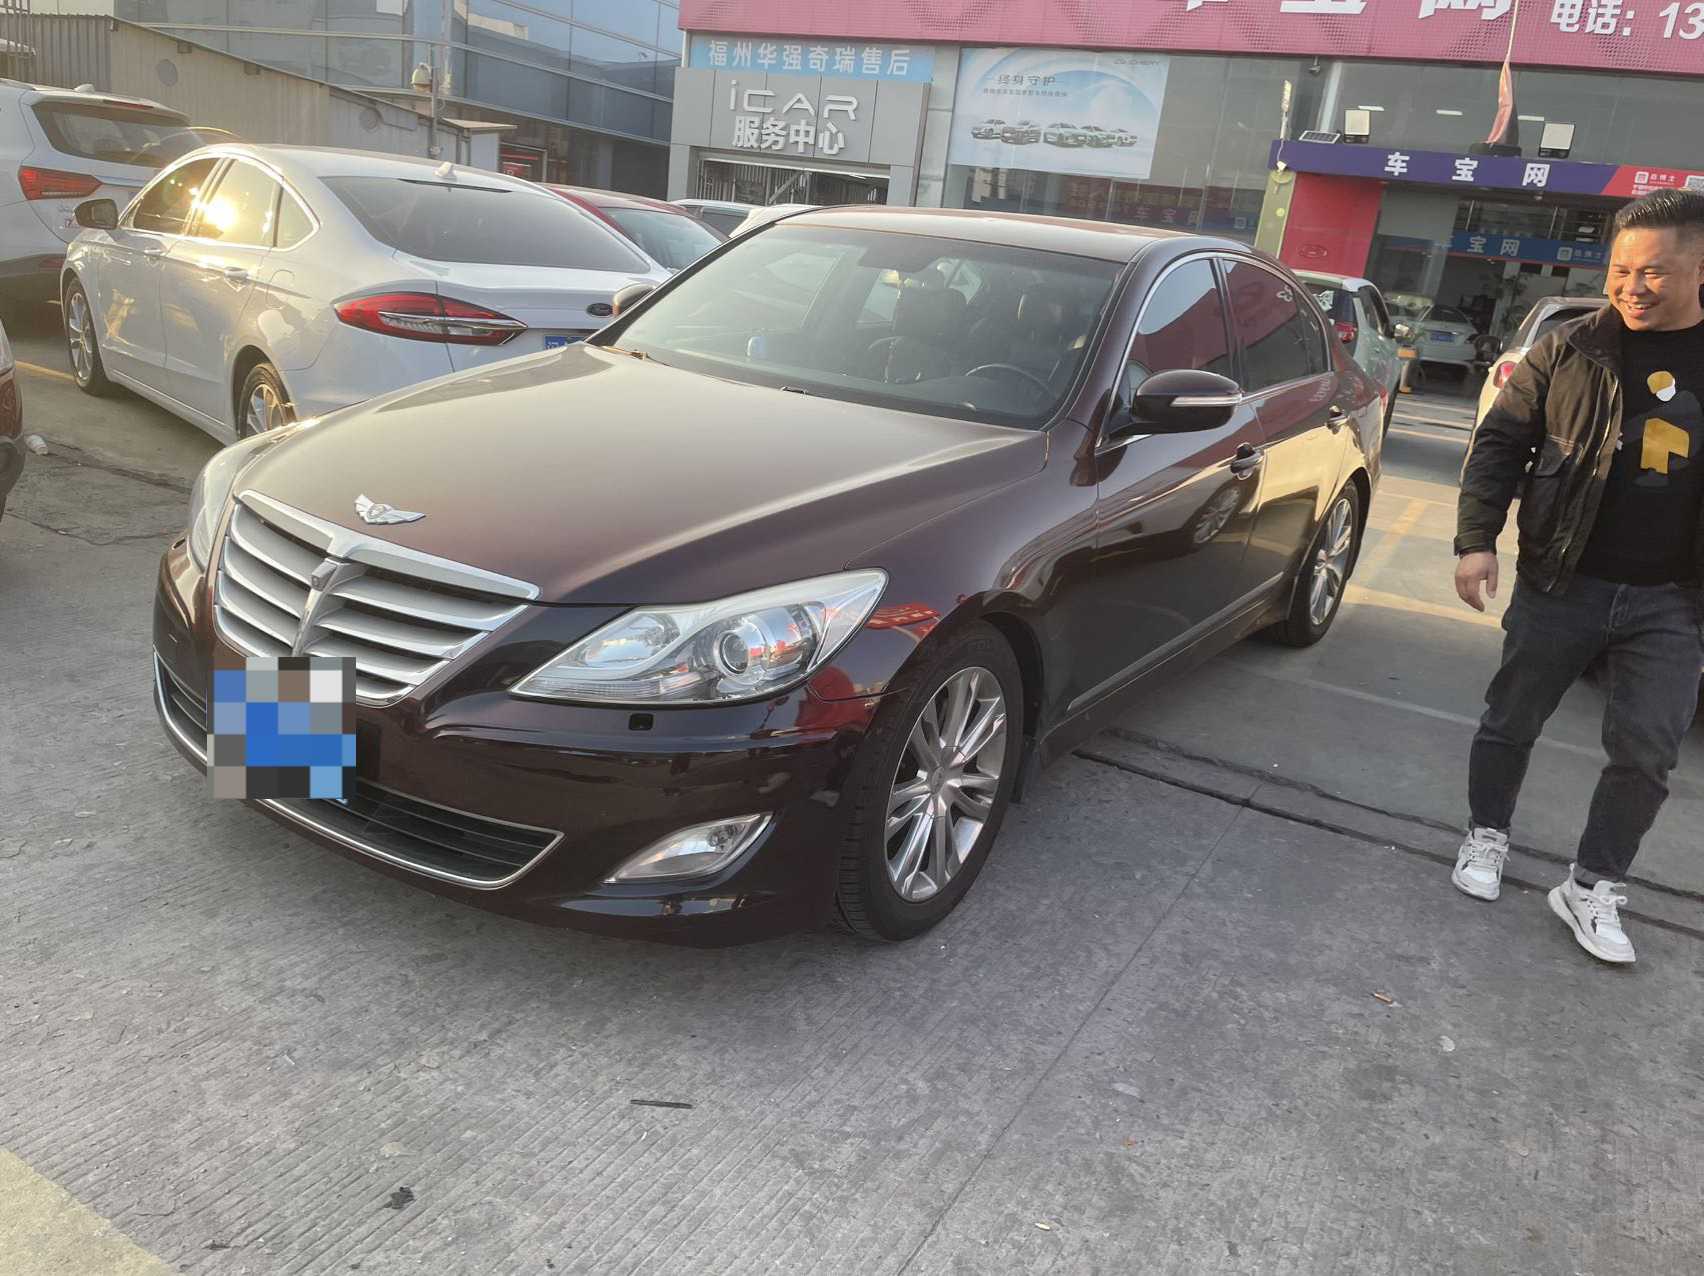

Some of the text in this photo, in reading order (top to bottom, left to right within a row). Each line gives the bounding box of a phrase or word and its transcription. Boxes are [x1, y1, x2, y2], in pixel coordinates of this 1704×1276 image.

[708, 40, 911, 76] 福州华强奇瑞售后
[729, 79, 859, 121] iCAR
[732, 115, 845, 155] 服务中心
[1384, 151, 1550, 188] 车宝网
